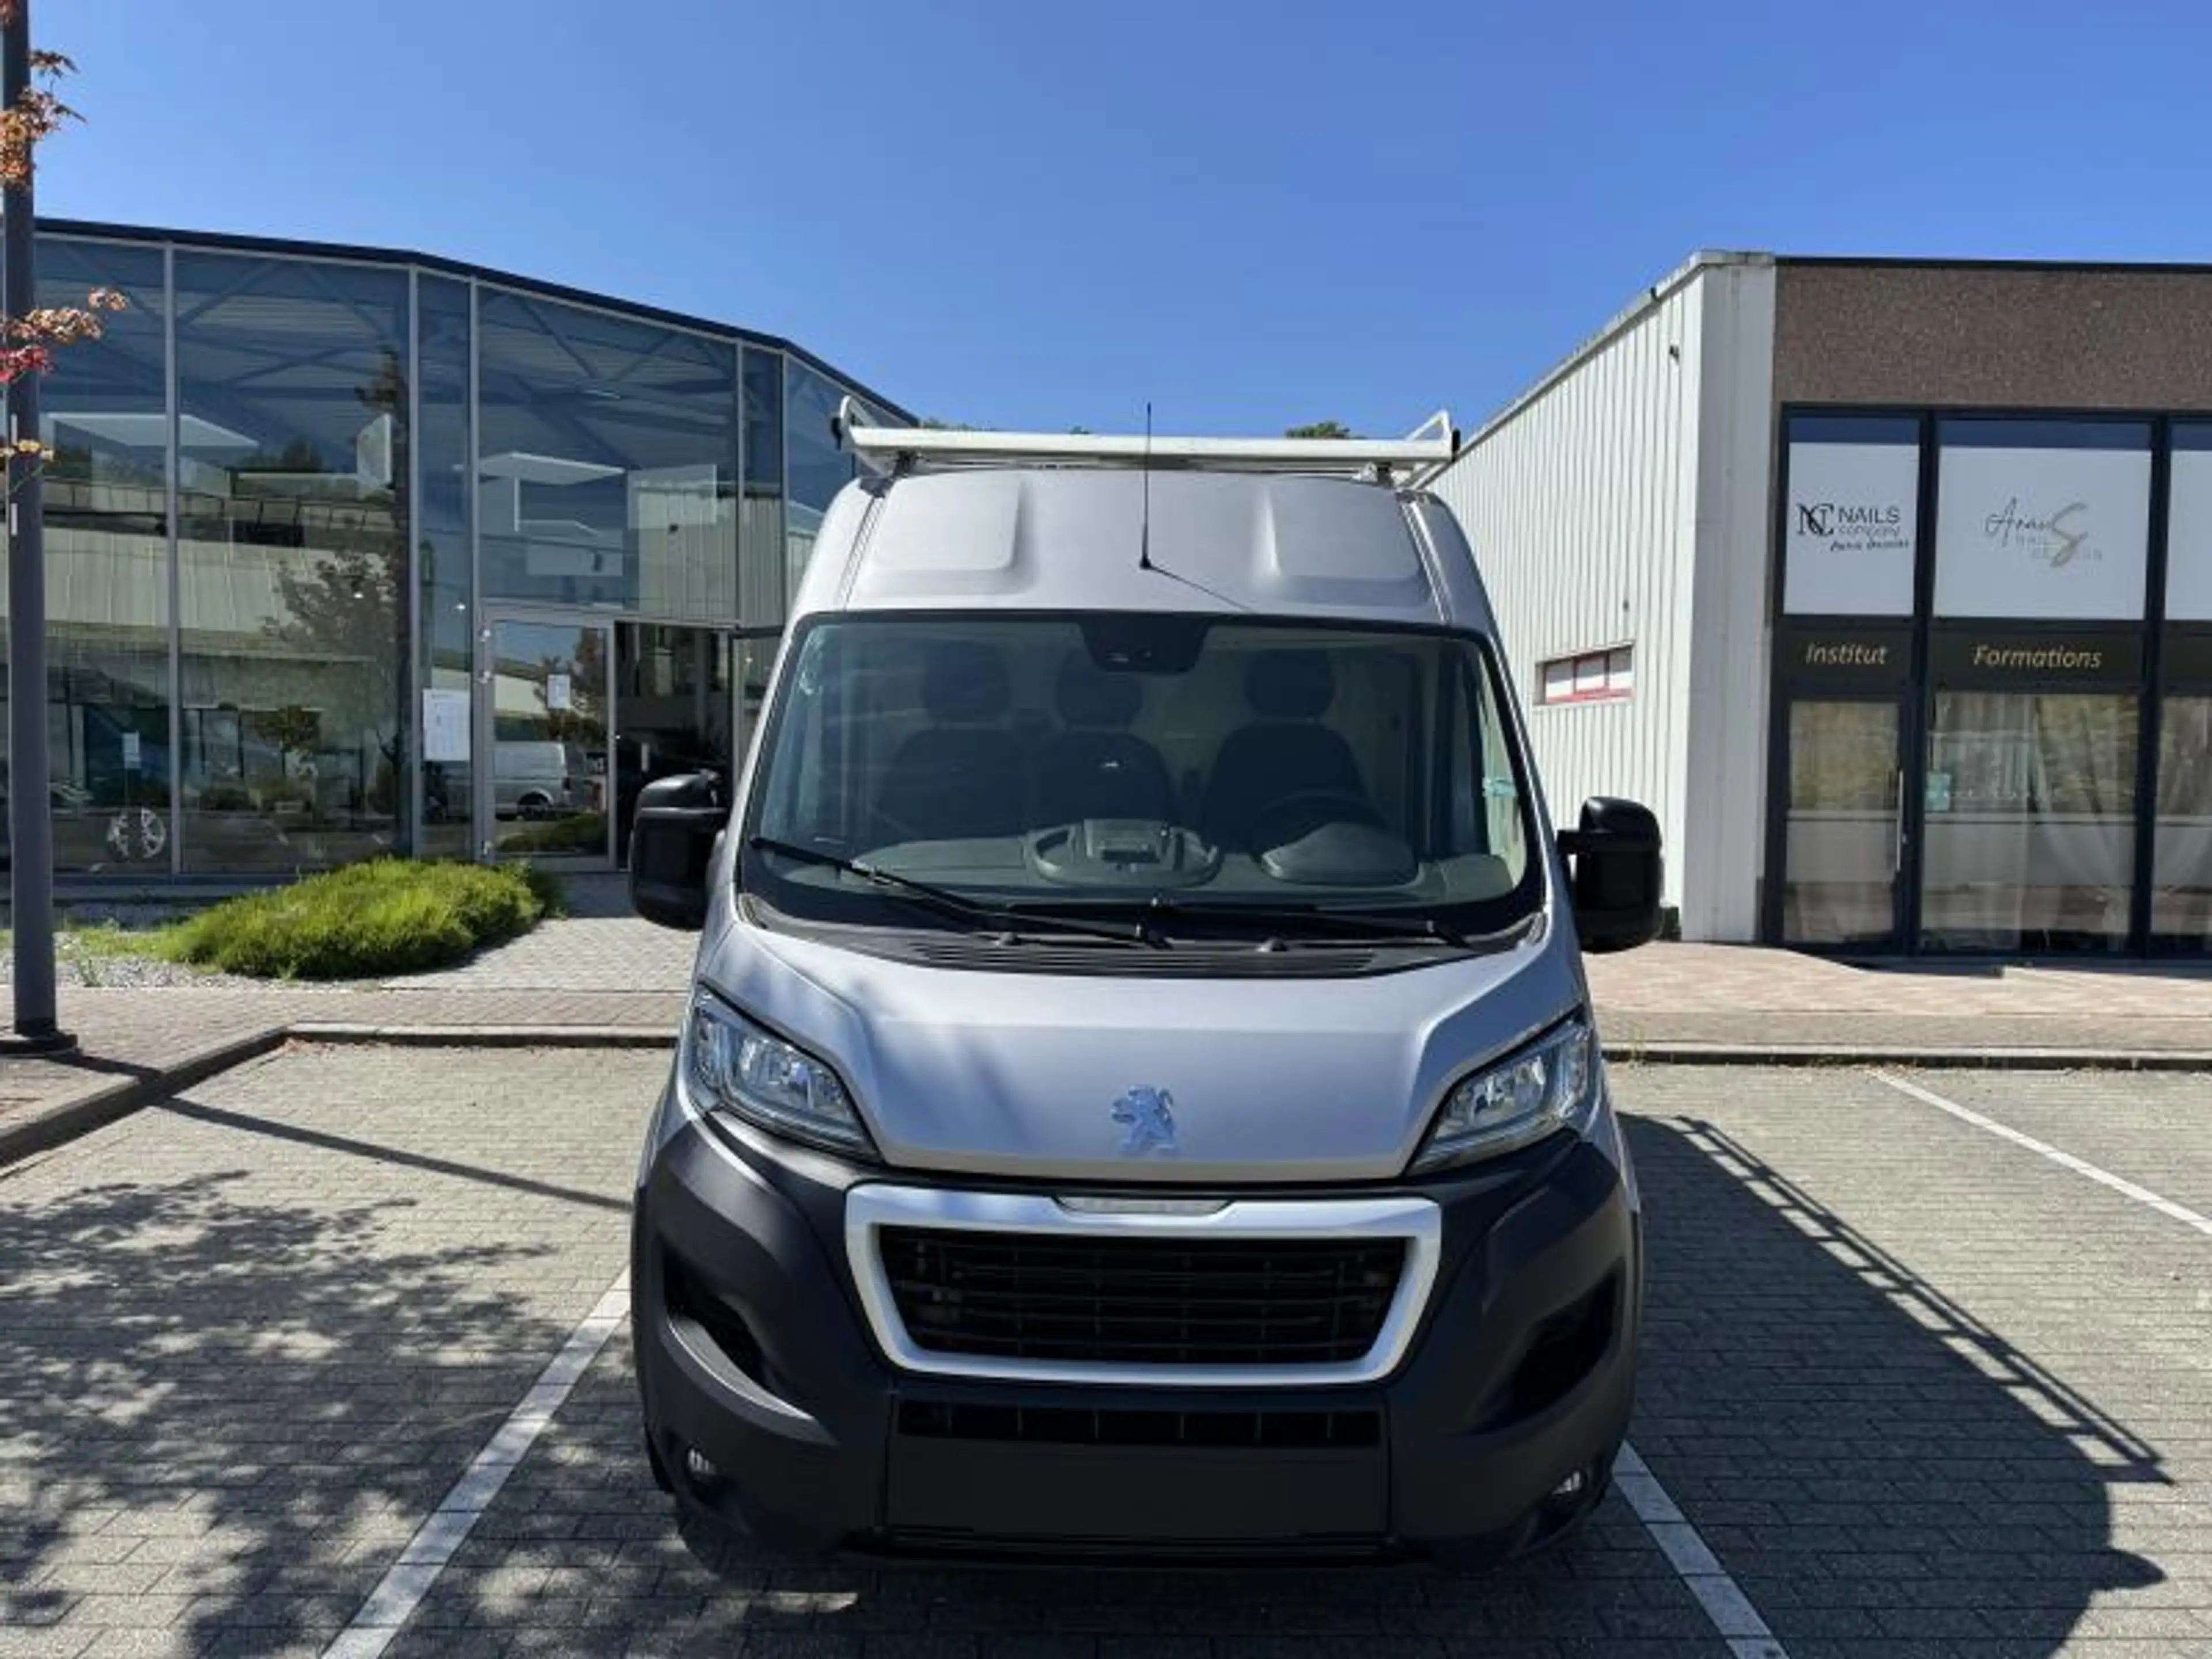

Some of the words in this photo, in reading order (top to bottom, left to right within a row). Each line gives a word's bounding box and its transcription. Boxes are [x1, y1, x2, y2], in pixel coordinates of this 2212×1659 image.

[1838, 505, 1900, 524] NAILS
[1805, 641, 1887, 665] Institut
[1973, 643, 2103, 669] Formations
